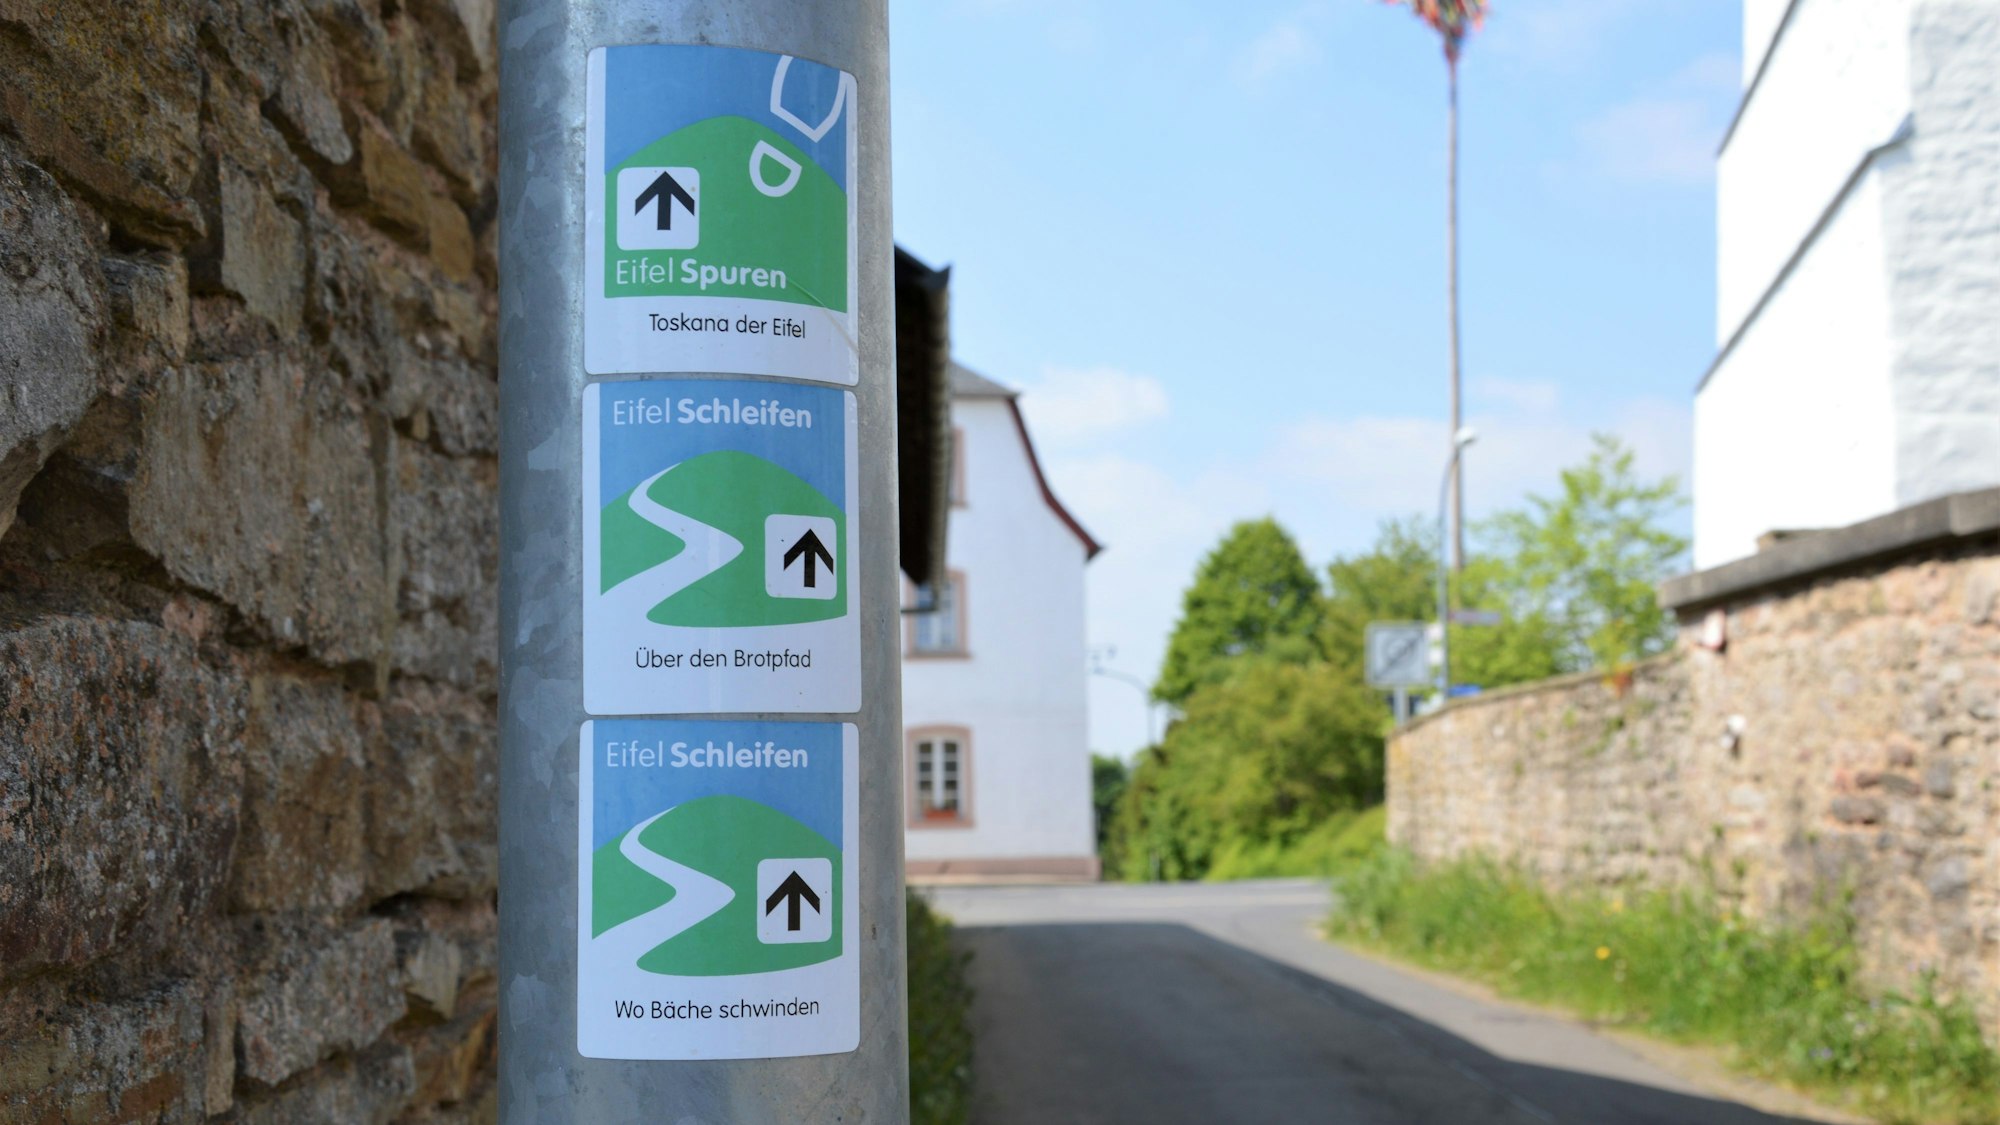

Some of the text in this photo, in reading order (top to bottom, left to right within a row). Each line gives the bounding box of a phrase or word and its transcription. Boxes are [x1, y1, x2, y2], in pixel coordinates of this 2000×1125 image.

[616, 257, 786, 290] Eifel Spuren
[649, 313, 806, 338] Toskana der Eifel
[613, 398, 811, 429] Eifel Schleifen
[635, 647, 811, 672] Über den Brotpfad
[607, 740, 808, 768] Eifel Schleifen
[615, 997, 819, 1019] Wo Bäche schwinden
